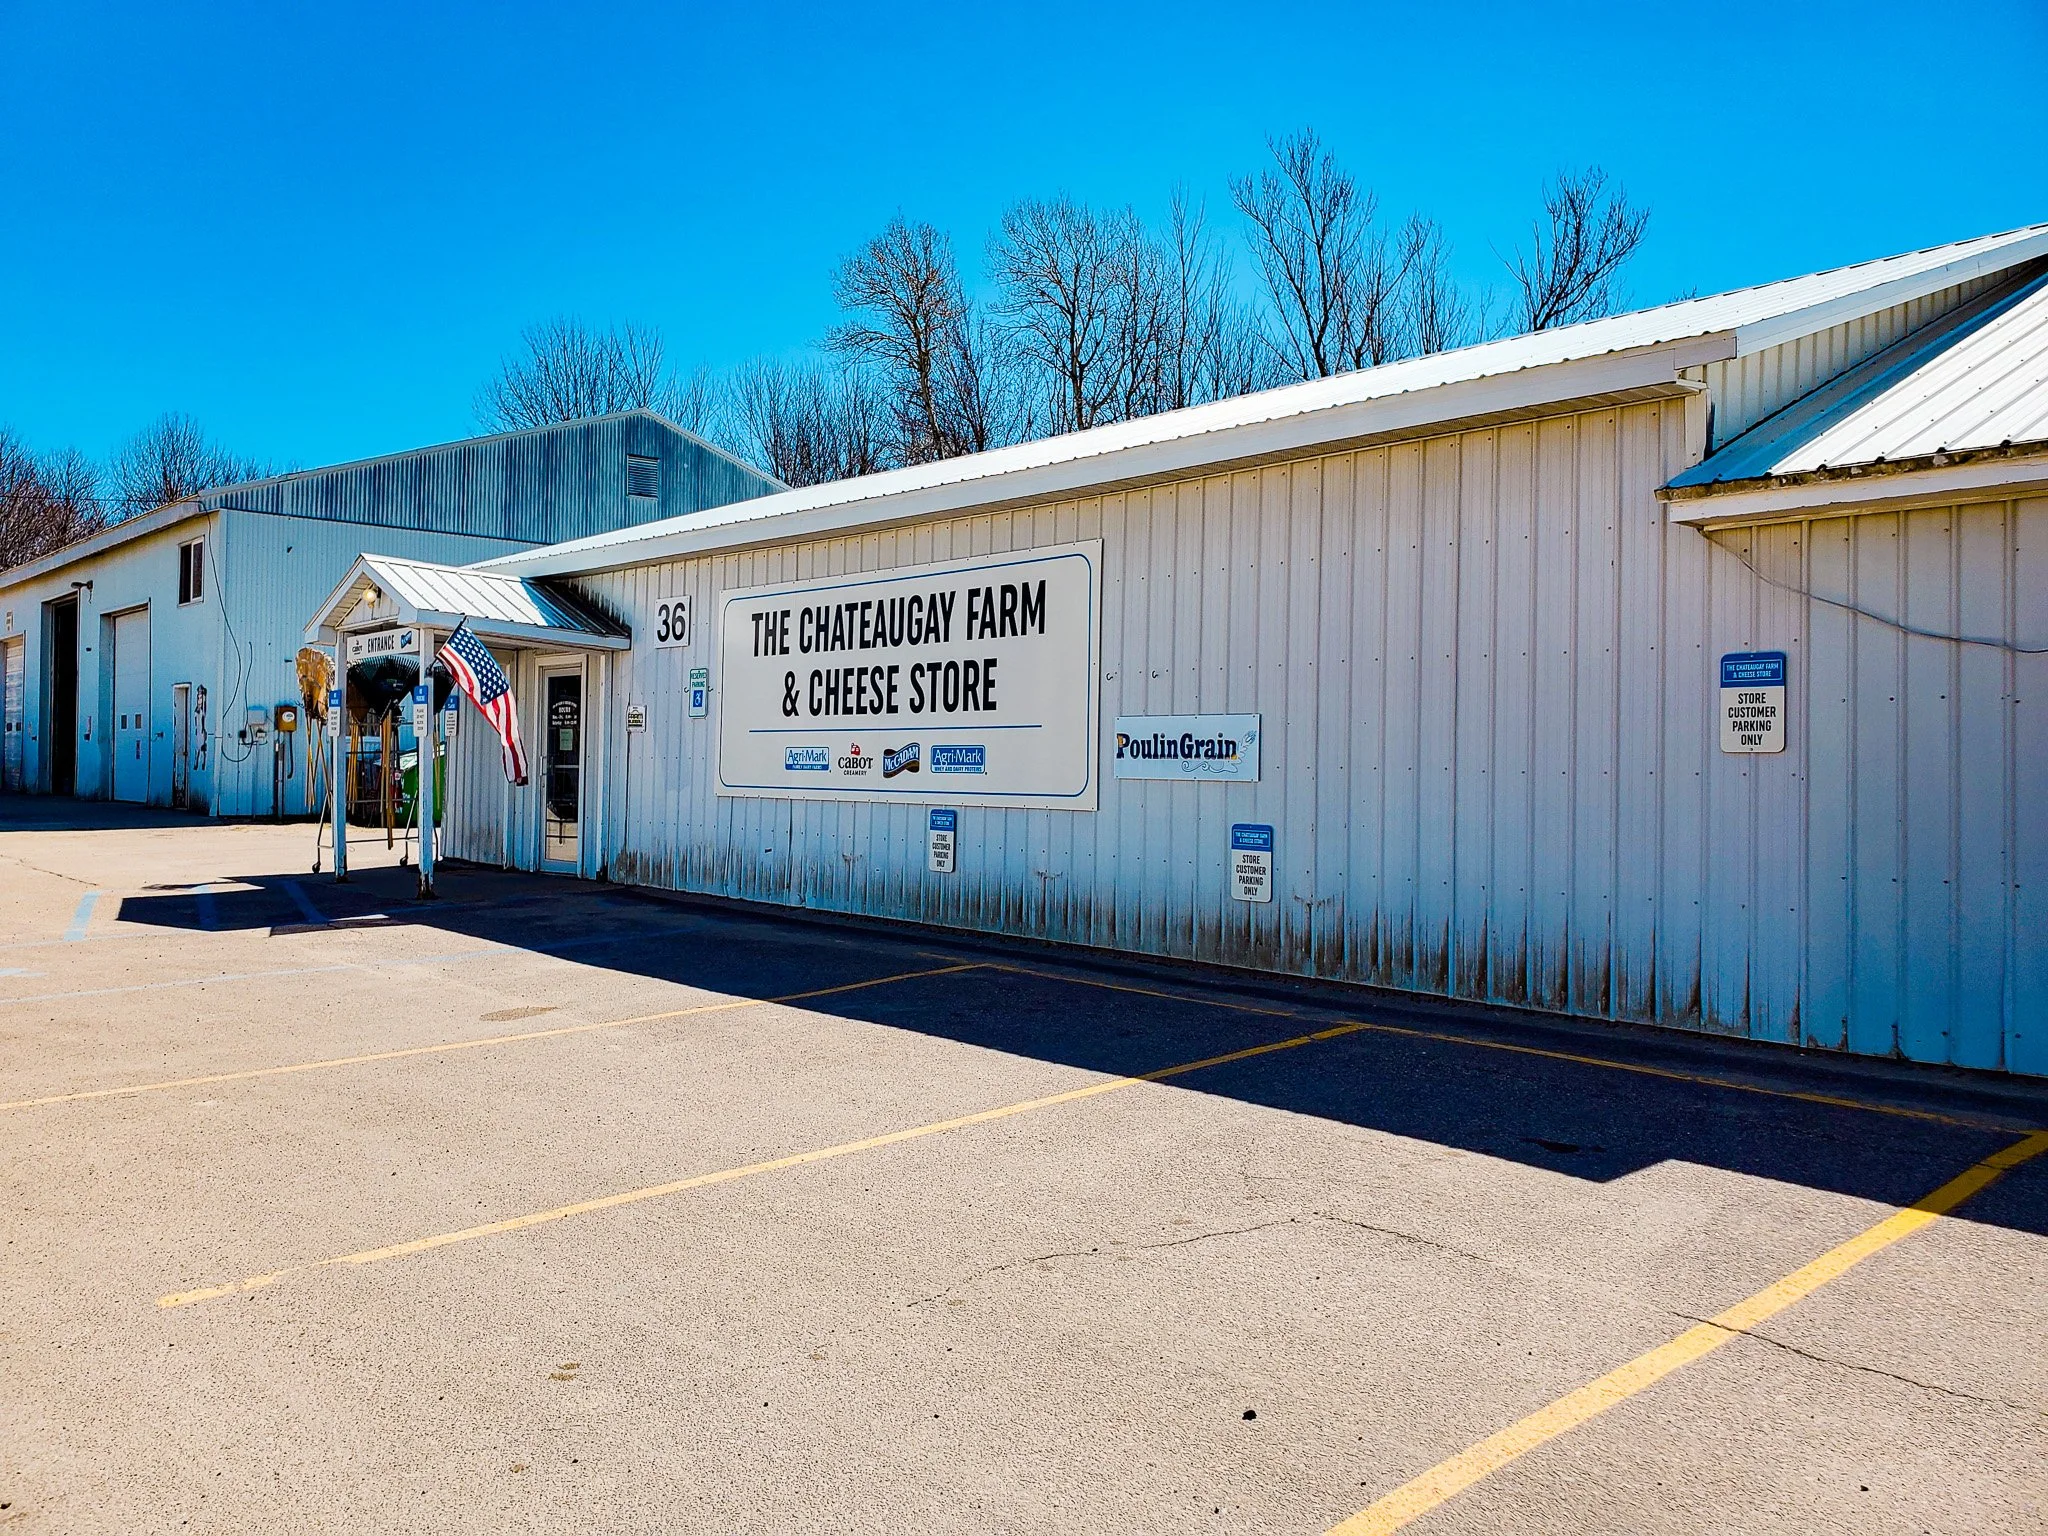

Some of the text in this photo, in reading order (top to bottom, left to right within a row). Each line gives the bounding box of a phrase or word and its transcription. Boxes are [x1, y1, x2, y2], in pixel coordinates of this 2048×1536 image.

[656, 602, 686, 642] 36
[751, 579, 1046, 657] THE CHATEAUGAY FARM
[368, 634, 394, 653] ENTRANCE
[782, 658, 998, 717] & CHEESE STORE
[1738, 693, 1766, 704] STORE
[1728, 706, 1776, 718] CUSTOMER
[1732, 720, 1772, 732] PARKING
[1116, 732, 1238, 760] PoulinGrain
[1741, 734, 1763, 746] ONLY
[1242, 854, 1260, 864] STORE
[1235, 864, 1266, 876] CUSTOMER
[1238, 875, 1263, 886] PARKING
[1243, 886, 1258, 896] ONLY
